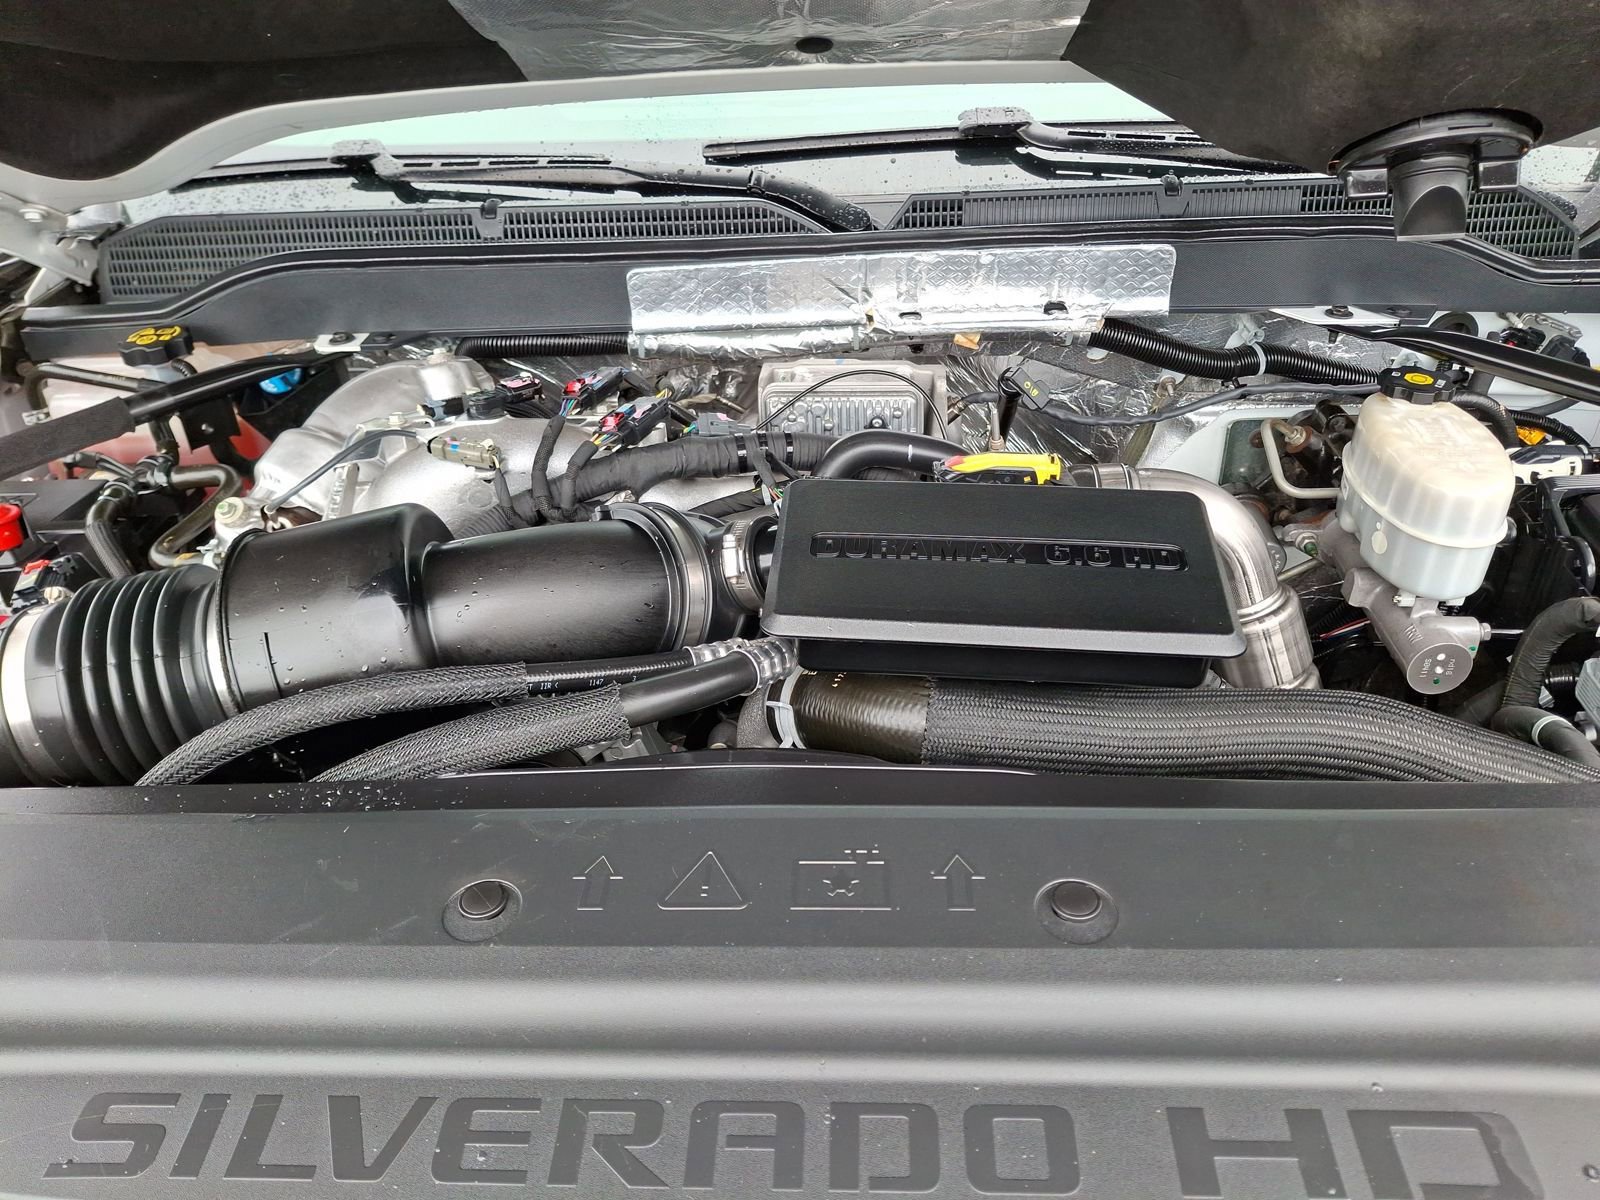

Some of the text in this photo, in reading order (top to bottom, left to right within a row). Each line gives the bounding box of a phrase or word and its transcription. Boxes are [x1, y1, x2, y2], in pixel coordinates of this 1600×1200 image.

[814, 535, 1182, 571] DURAMAX 6.6 HD
[41, 1092, 1546, 1200] SILVERADO HD
